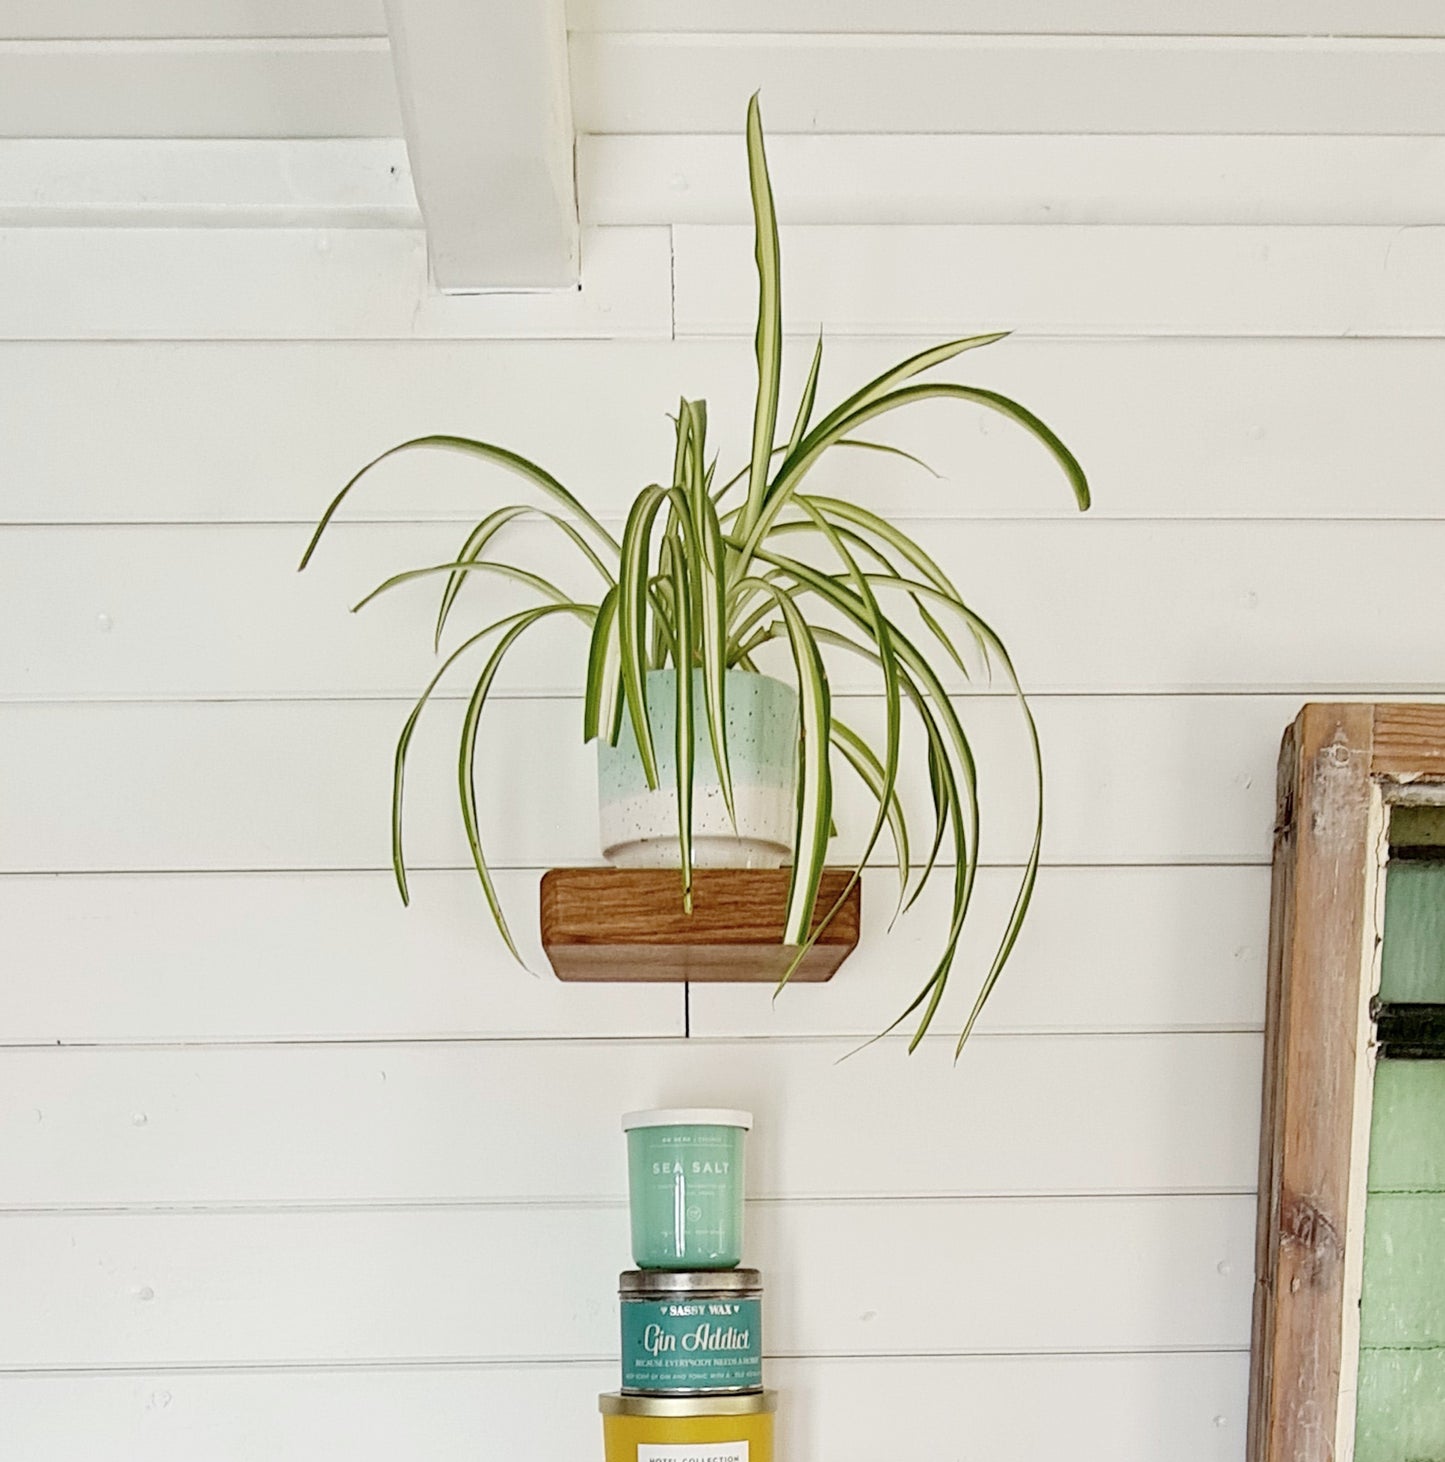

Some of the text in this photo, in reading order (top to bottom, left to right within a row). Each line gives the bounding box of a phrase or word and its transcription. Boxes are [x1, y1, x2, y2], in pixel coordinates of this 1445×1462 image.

[652, 1161, 729, 1175] SEA SALT
[669, 1304, 732, 1317] SASSY WAX
[644, 1322, 750, 1357] Gin Addict
